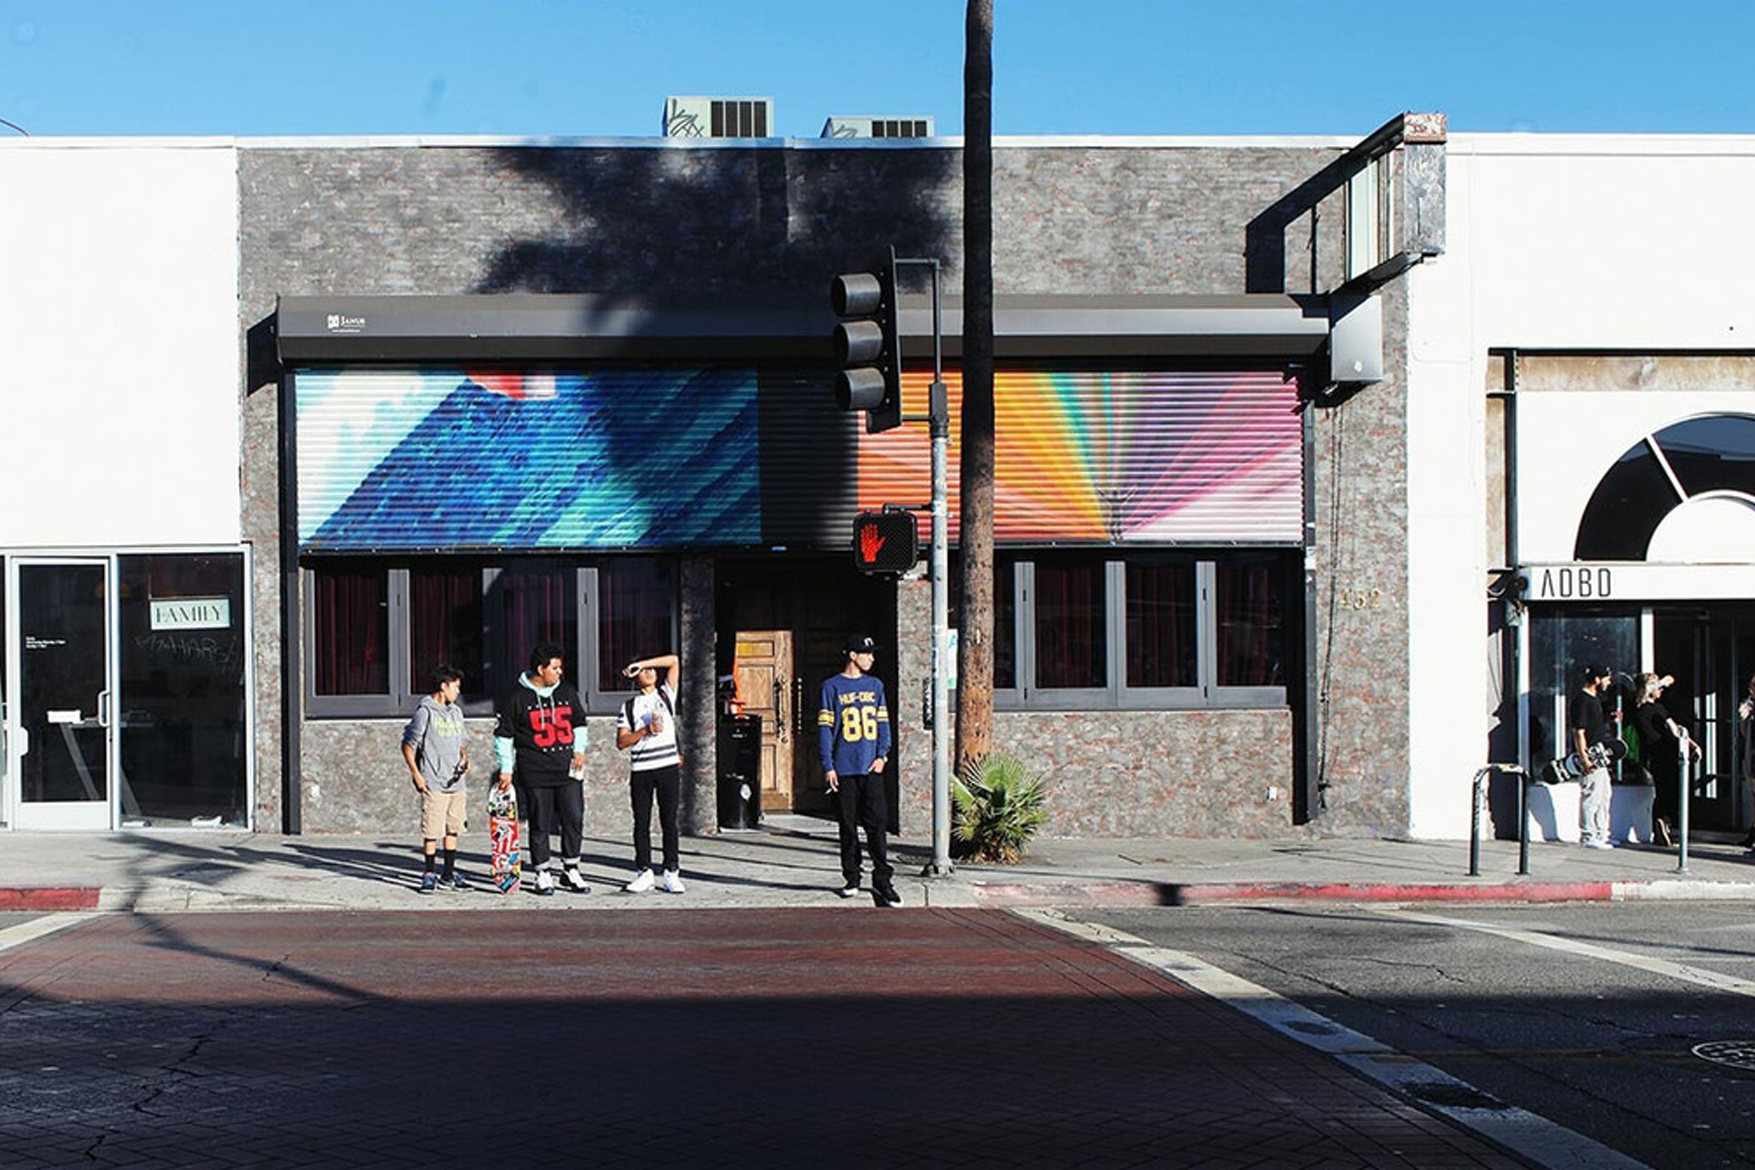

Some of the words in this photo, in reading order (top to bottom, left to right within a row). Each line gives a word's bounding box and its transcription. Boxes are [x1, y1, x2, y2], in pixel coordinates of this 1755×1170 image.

[156, 605, 221, 623] FAMILY
[529, 706, 574, 747] 55
[842, 706, 878, 742] 86
